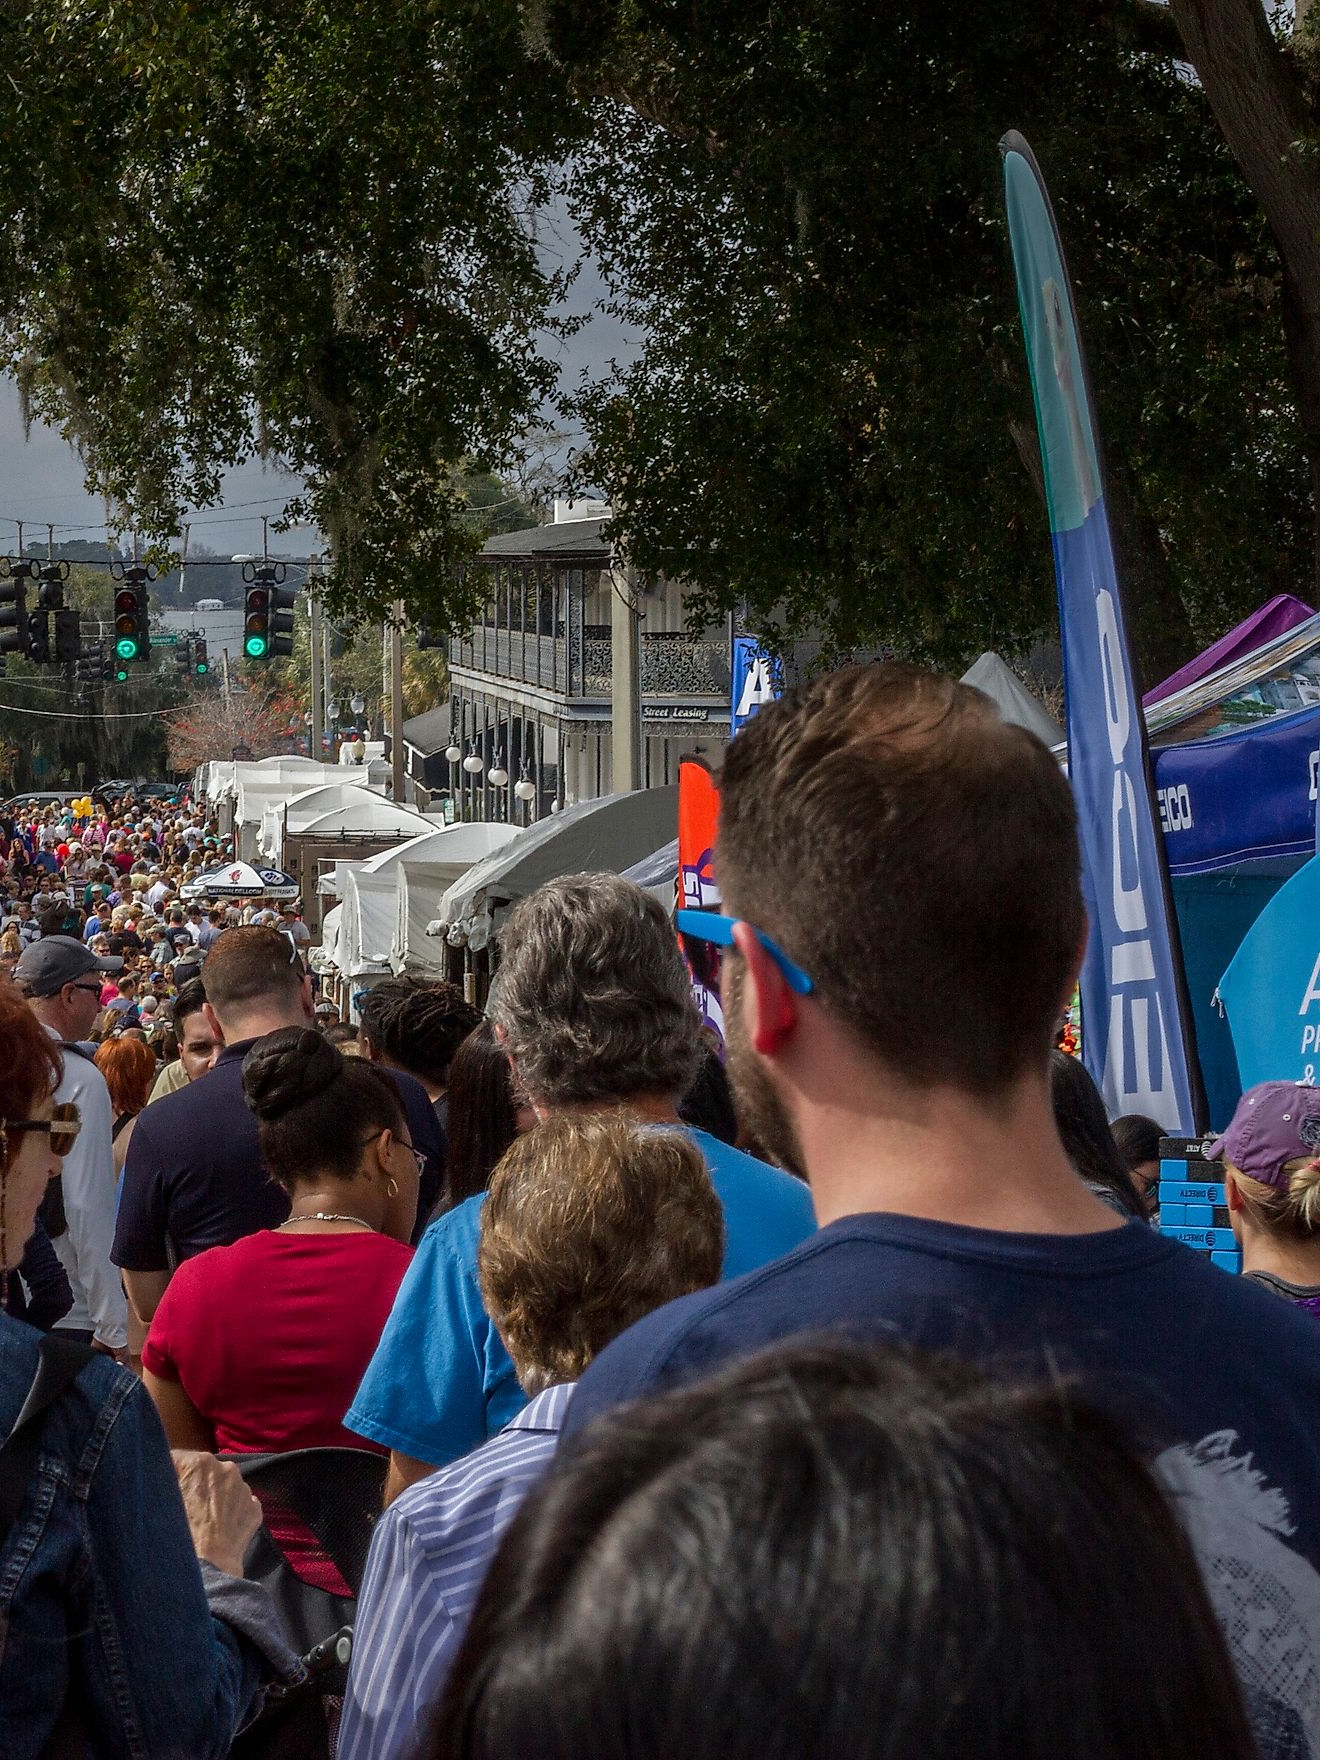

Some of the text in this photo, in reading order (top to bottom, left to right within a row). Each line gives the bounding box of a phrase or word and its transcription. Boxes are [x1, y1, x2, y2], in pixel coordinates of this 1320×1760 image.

[643, 706, 708, 720] Street Leasing
[1157, 783, 1193, 833] EICO
[1180, 1188, 1206, 1198] DIRECTV
